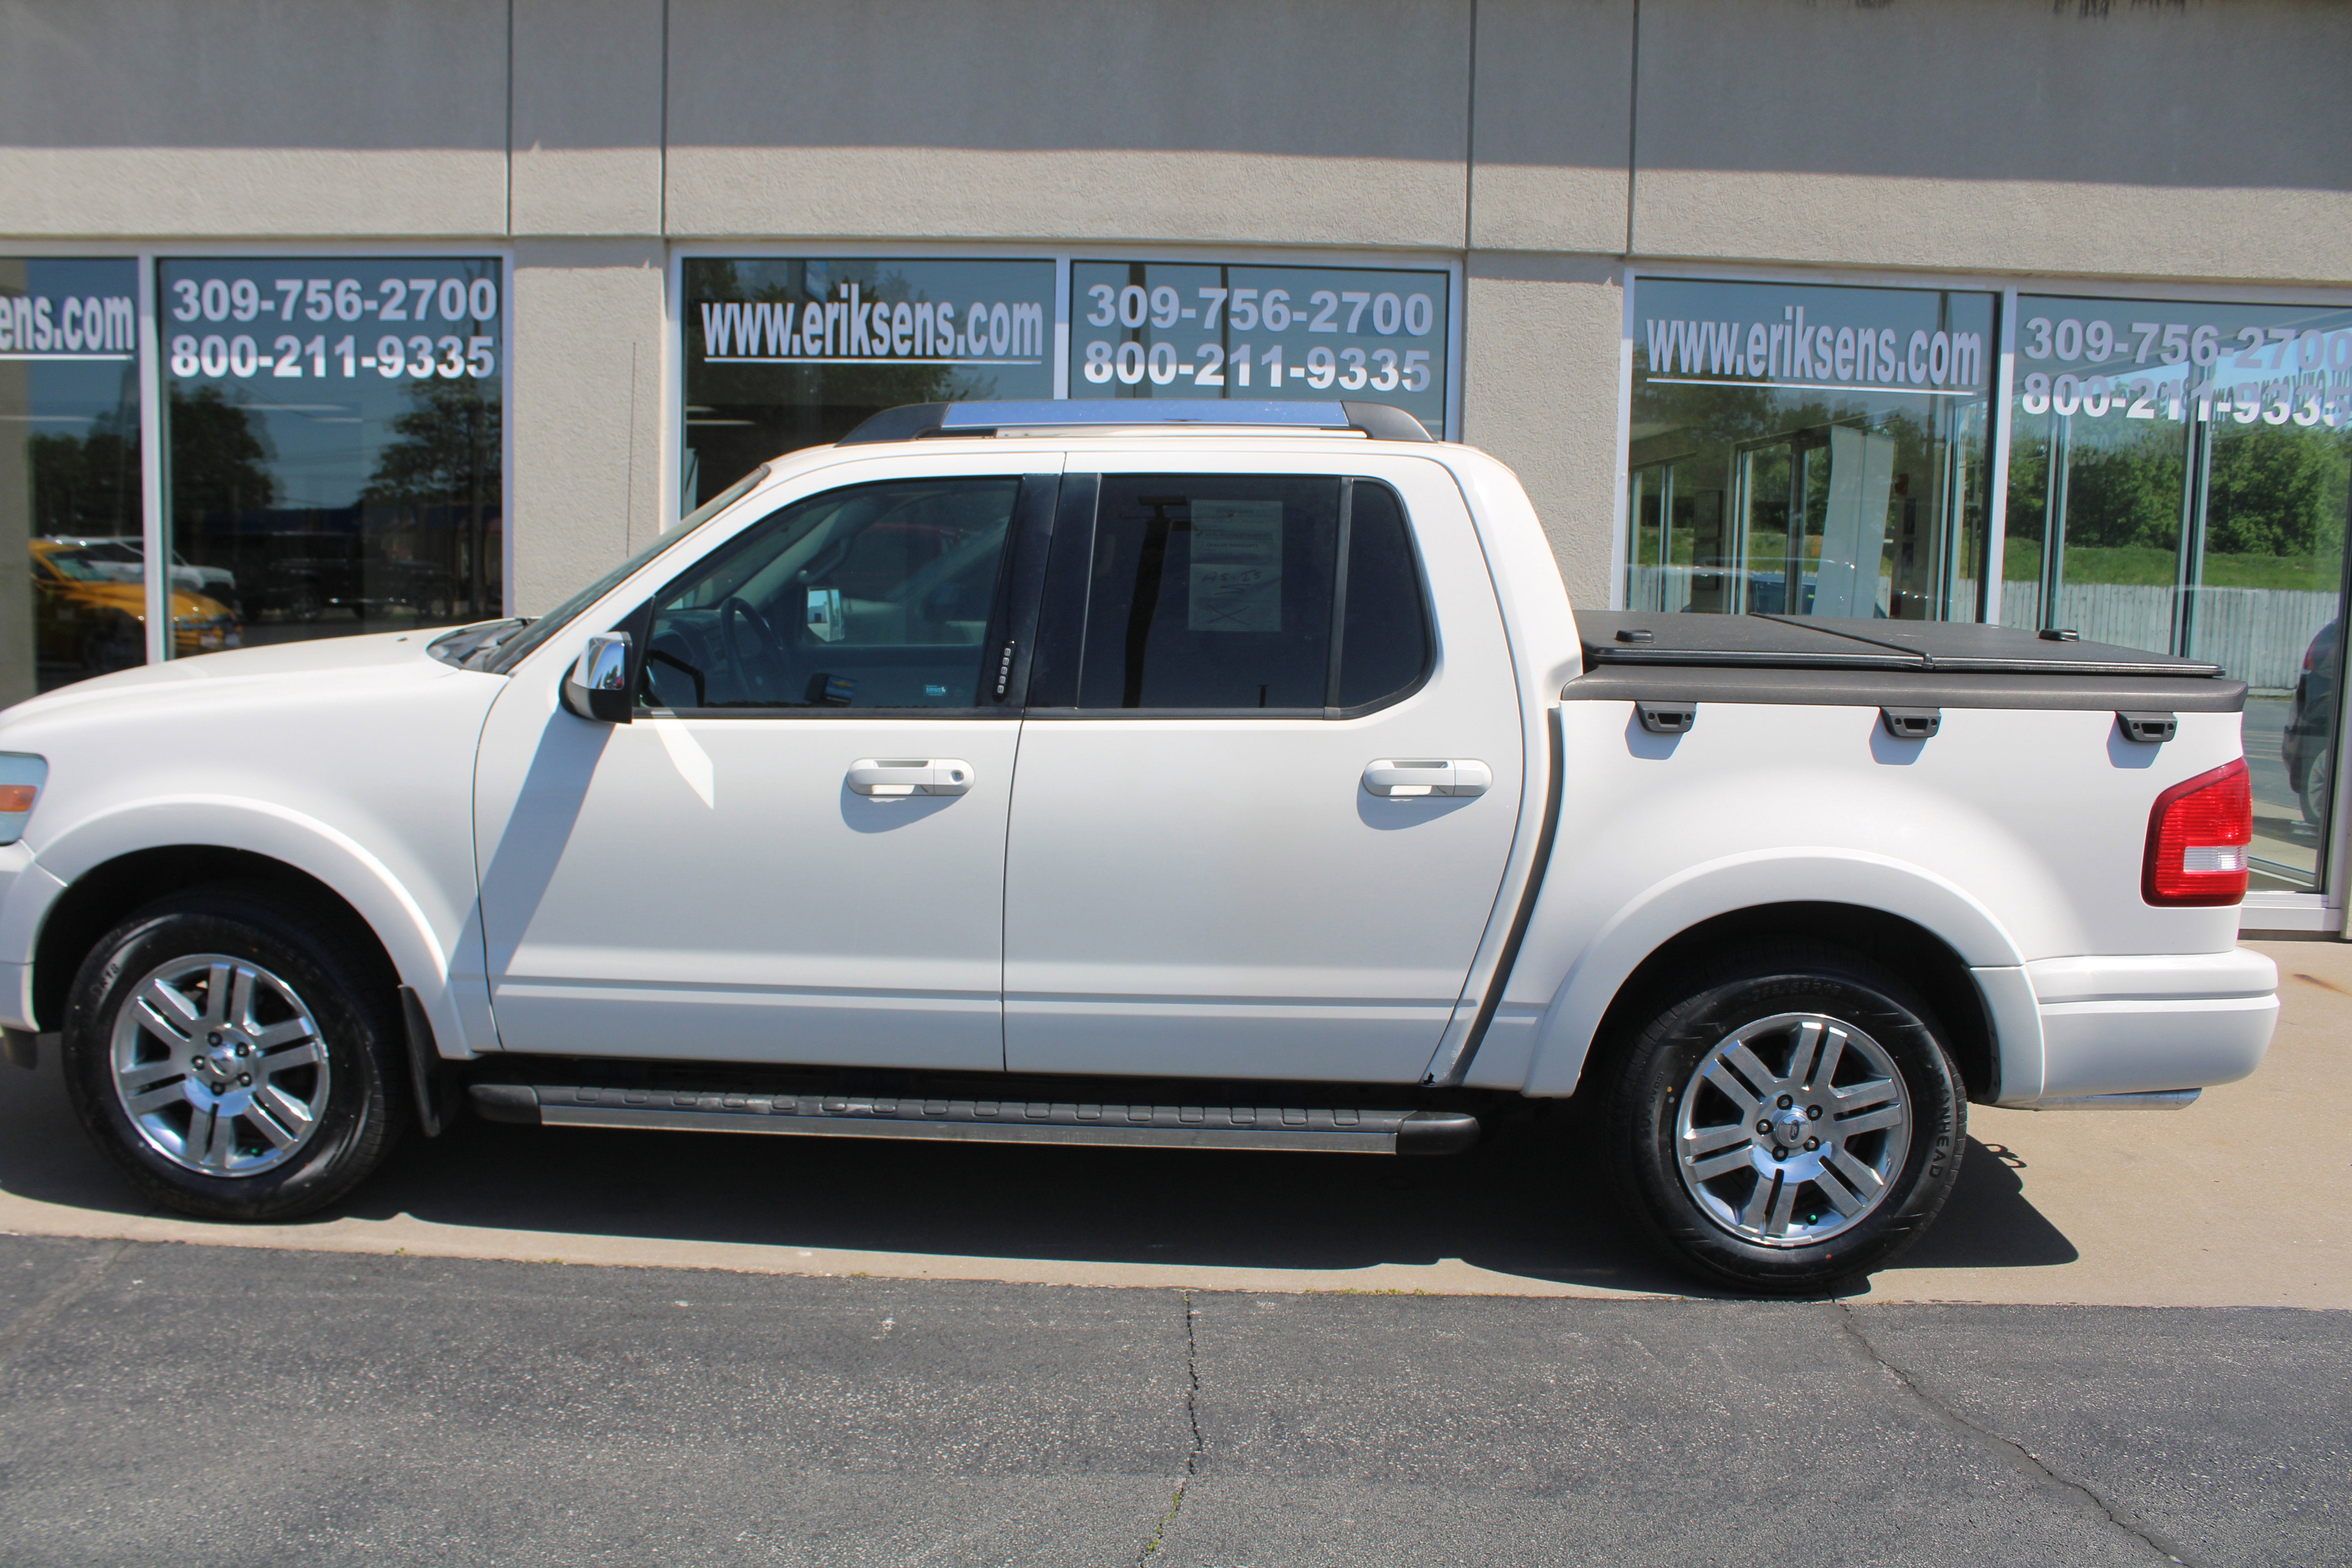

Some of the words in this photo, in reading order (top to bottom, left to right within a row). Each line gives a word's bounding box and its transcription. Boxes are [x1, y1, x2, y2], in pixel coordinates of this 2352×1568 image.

[173, 278, 497, 321] 309-756-2700
[701, 282, 1043, 356] www.eriksens.com
[1087, 284, 1433, 336] 309-756-2700
[171, 334, 495, 378] 800-211-9335
[1084, 341, 1431, 392] 800-211-9335
[1646, 306, 1981, 385] www.eriksens.com
[2024, 317, 2352, 372] 309-756-2700
[2022, 372, 2351, 427] 800-211-9335
